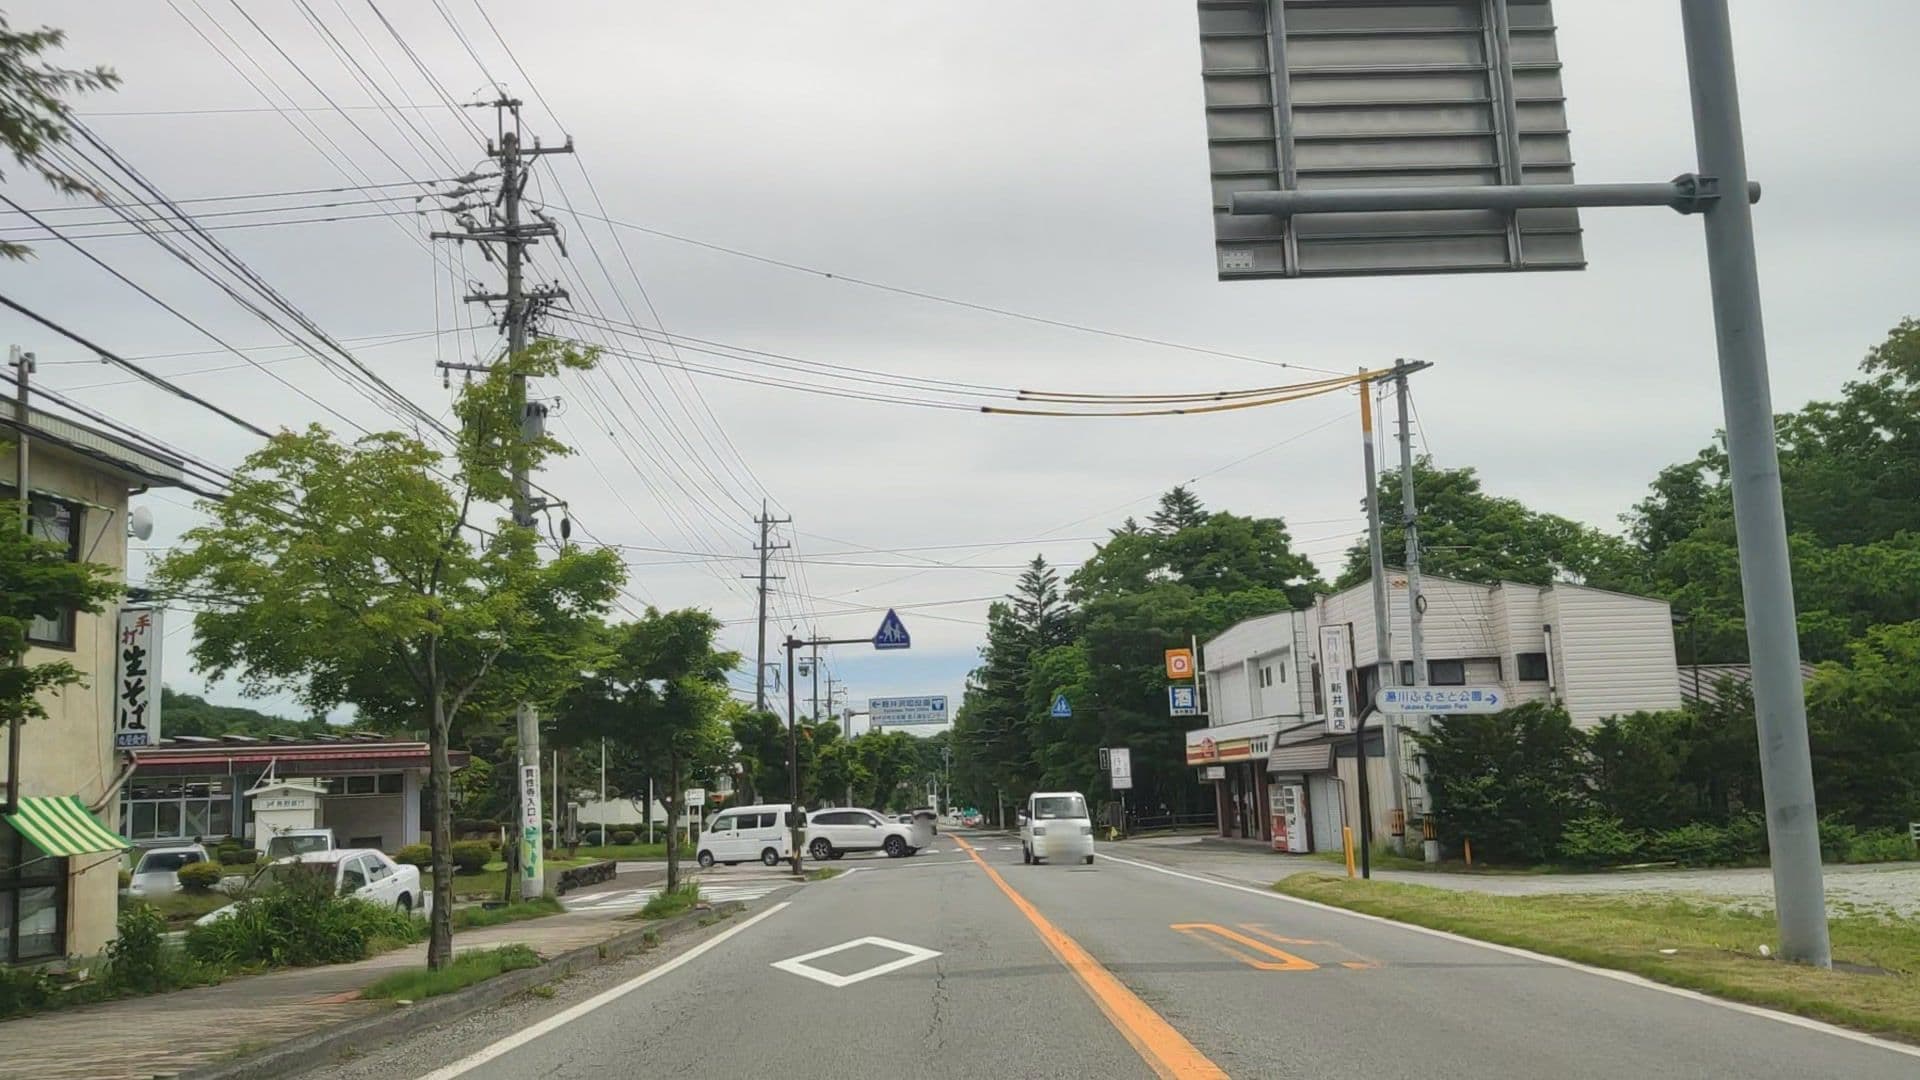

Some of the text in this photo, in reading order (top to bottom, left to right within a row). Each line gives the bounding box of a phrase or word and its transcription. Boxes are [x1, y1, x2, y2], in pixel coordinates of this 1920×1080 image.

[1174, 688, 1192, 707] 酒
[1331, 683, 1345, 730] 新井酒店
